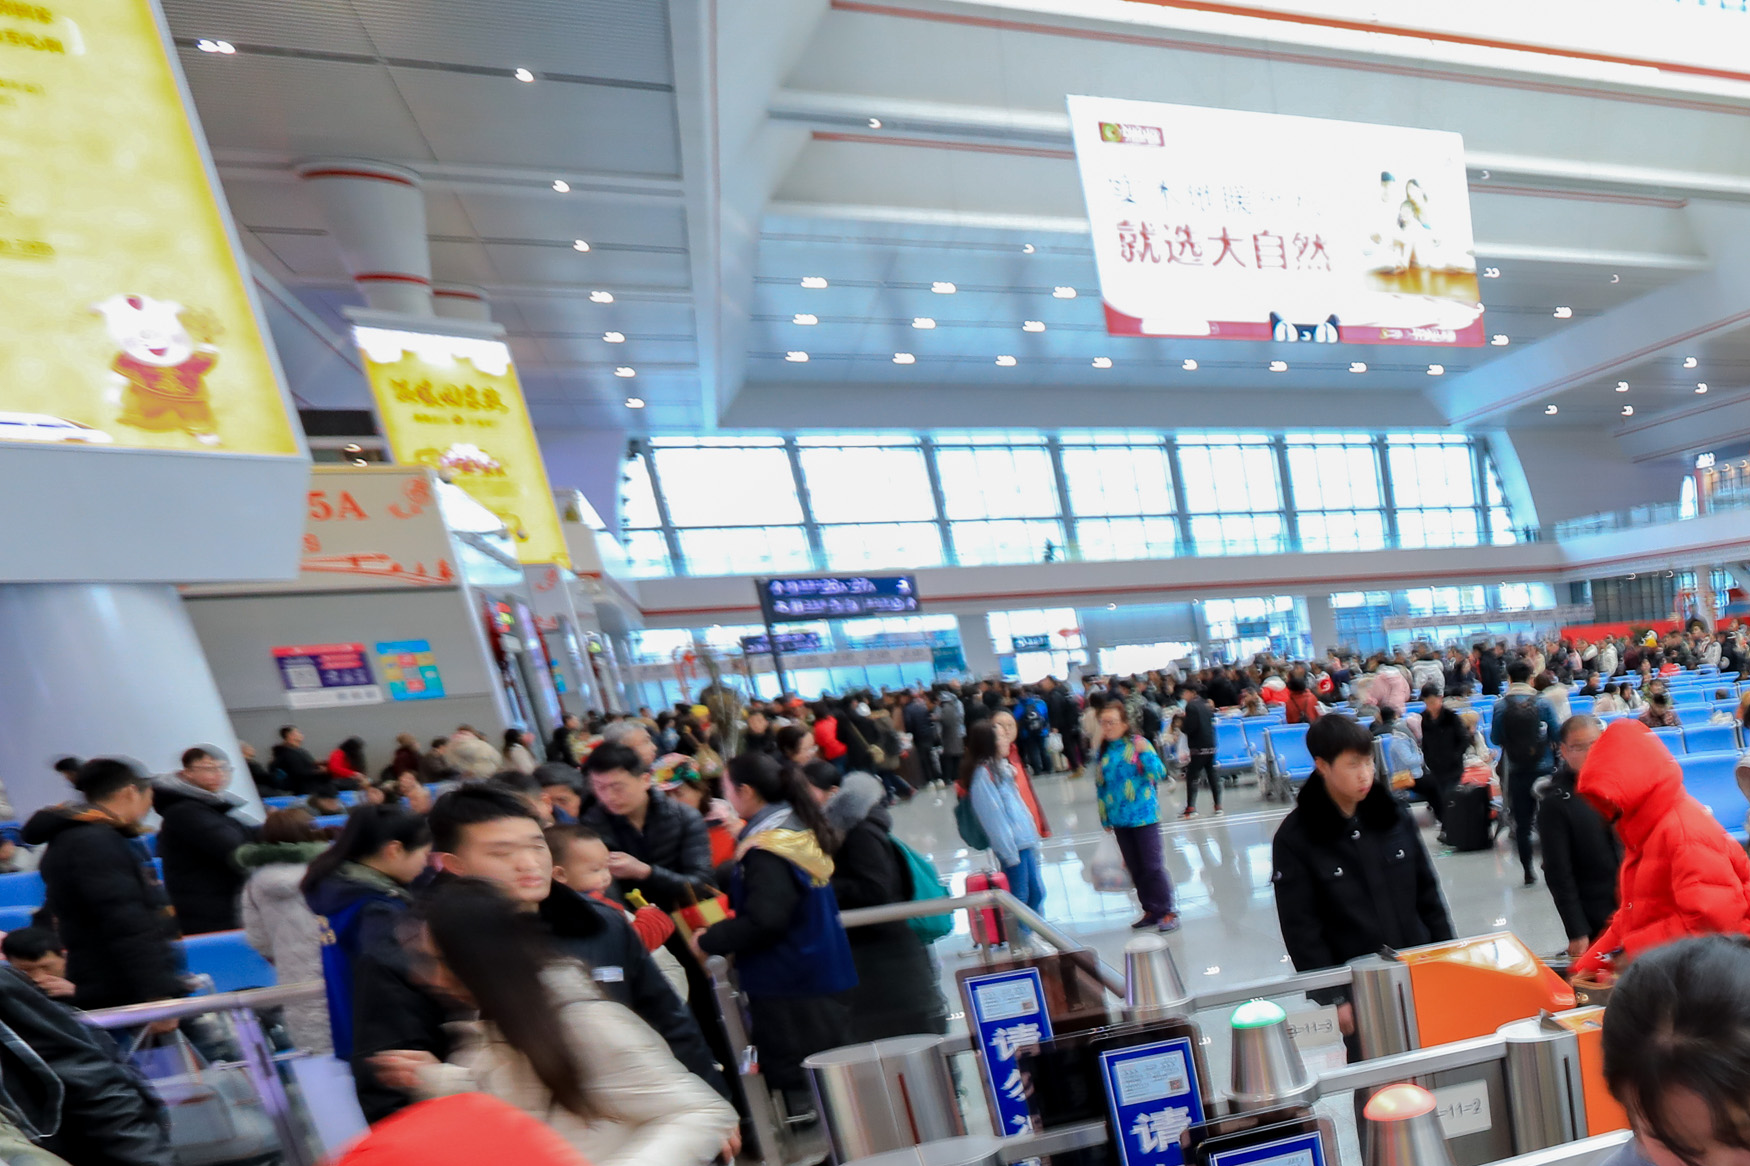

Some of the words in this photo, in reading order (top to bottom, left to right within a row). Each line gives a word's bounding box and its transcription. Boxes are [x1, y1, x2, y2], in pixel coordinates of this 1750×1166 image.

[1118, 219, 1333, 272] 就选大自然
